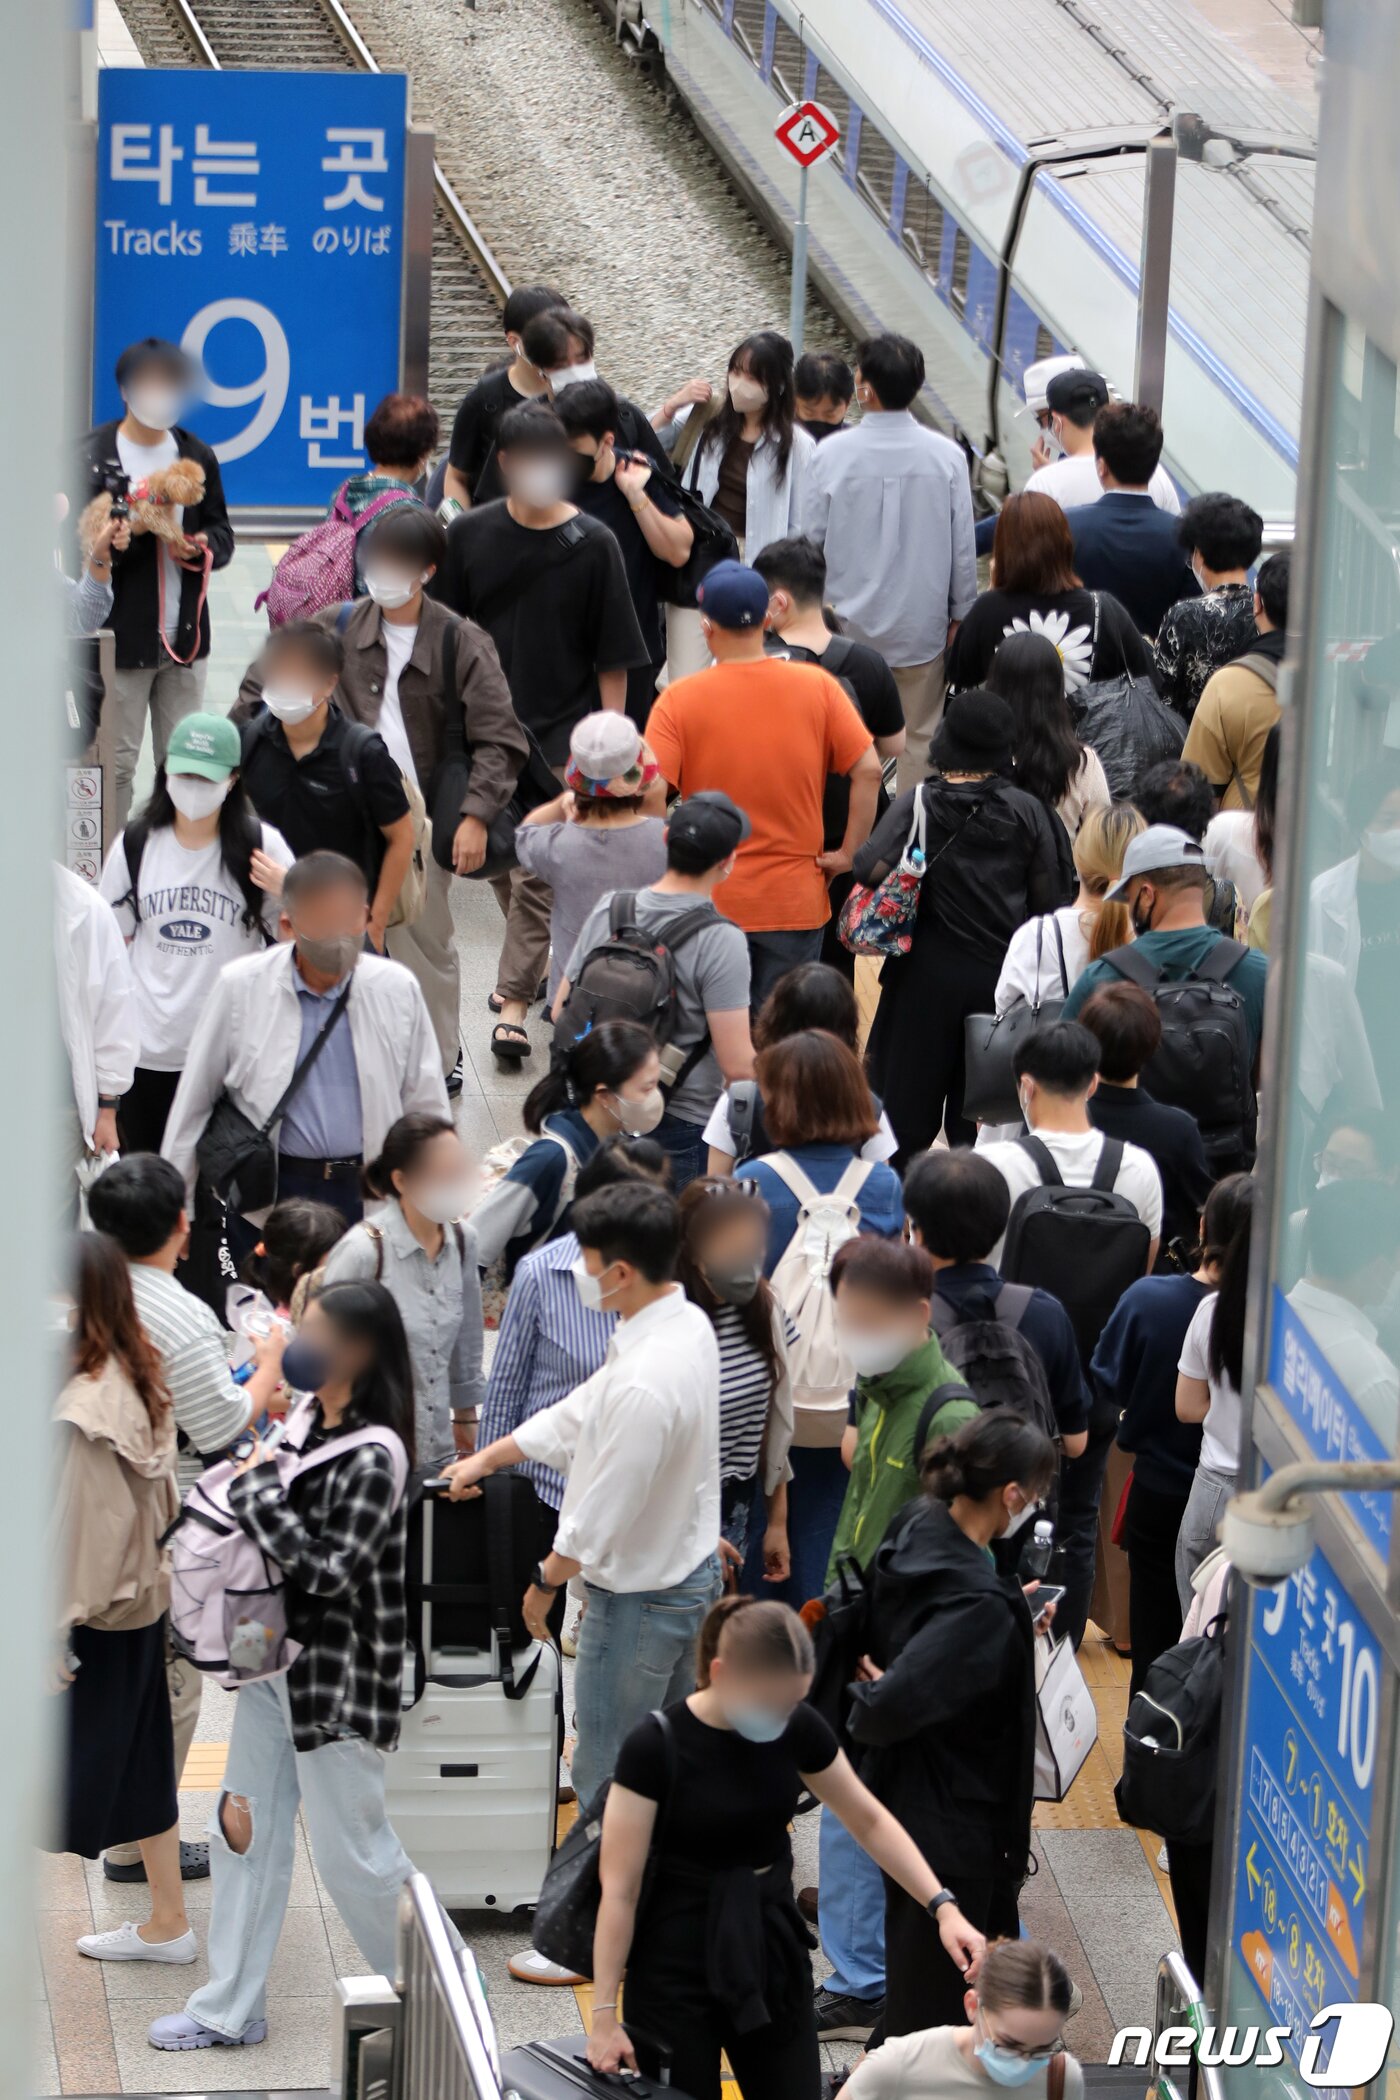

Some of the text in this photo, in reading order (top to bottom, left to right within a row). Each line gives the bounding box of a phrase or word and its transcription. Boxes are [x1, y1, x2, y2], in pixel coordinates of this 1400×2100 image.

[798, 121, 816, 142] A
[110, 123, 389, 212] 타는 곳
[103, 220, 203, 256] Tracks
[312, 225, 392, 256] のりば
[179, 297, 366, 469] 9 번
[140, 886, 241, 927] UNIVERSITY
[156, 942, 214, 957] AUTHENTIC
[168, 923, 203, 939] YALE
[1338, 1620, 1378, 1790] 10
